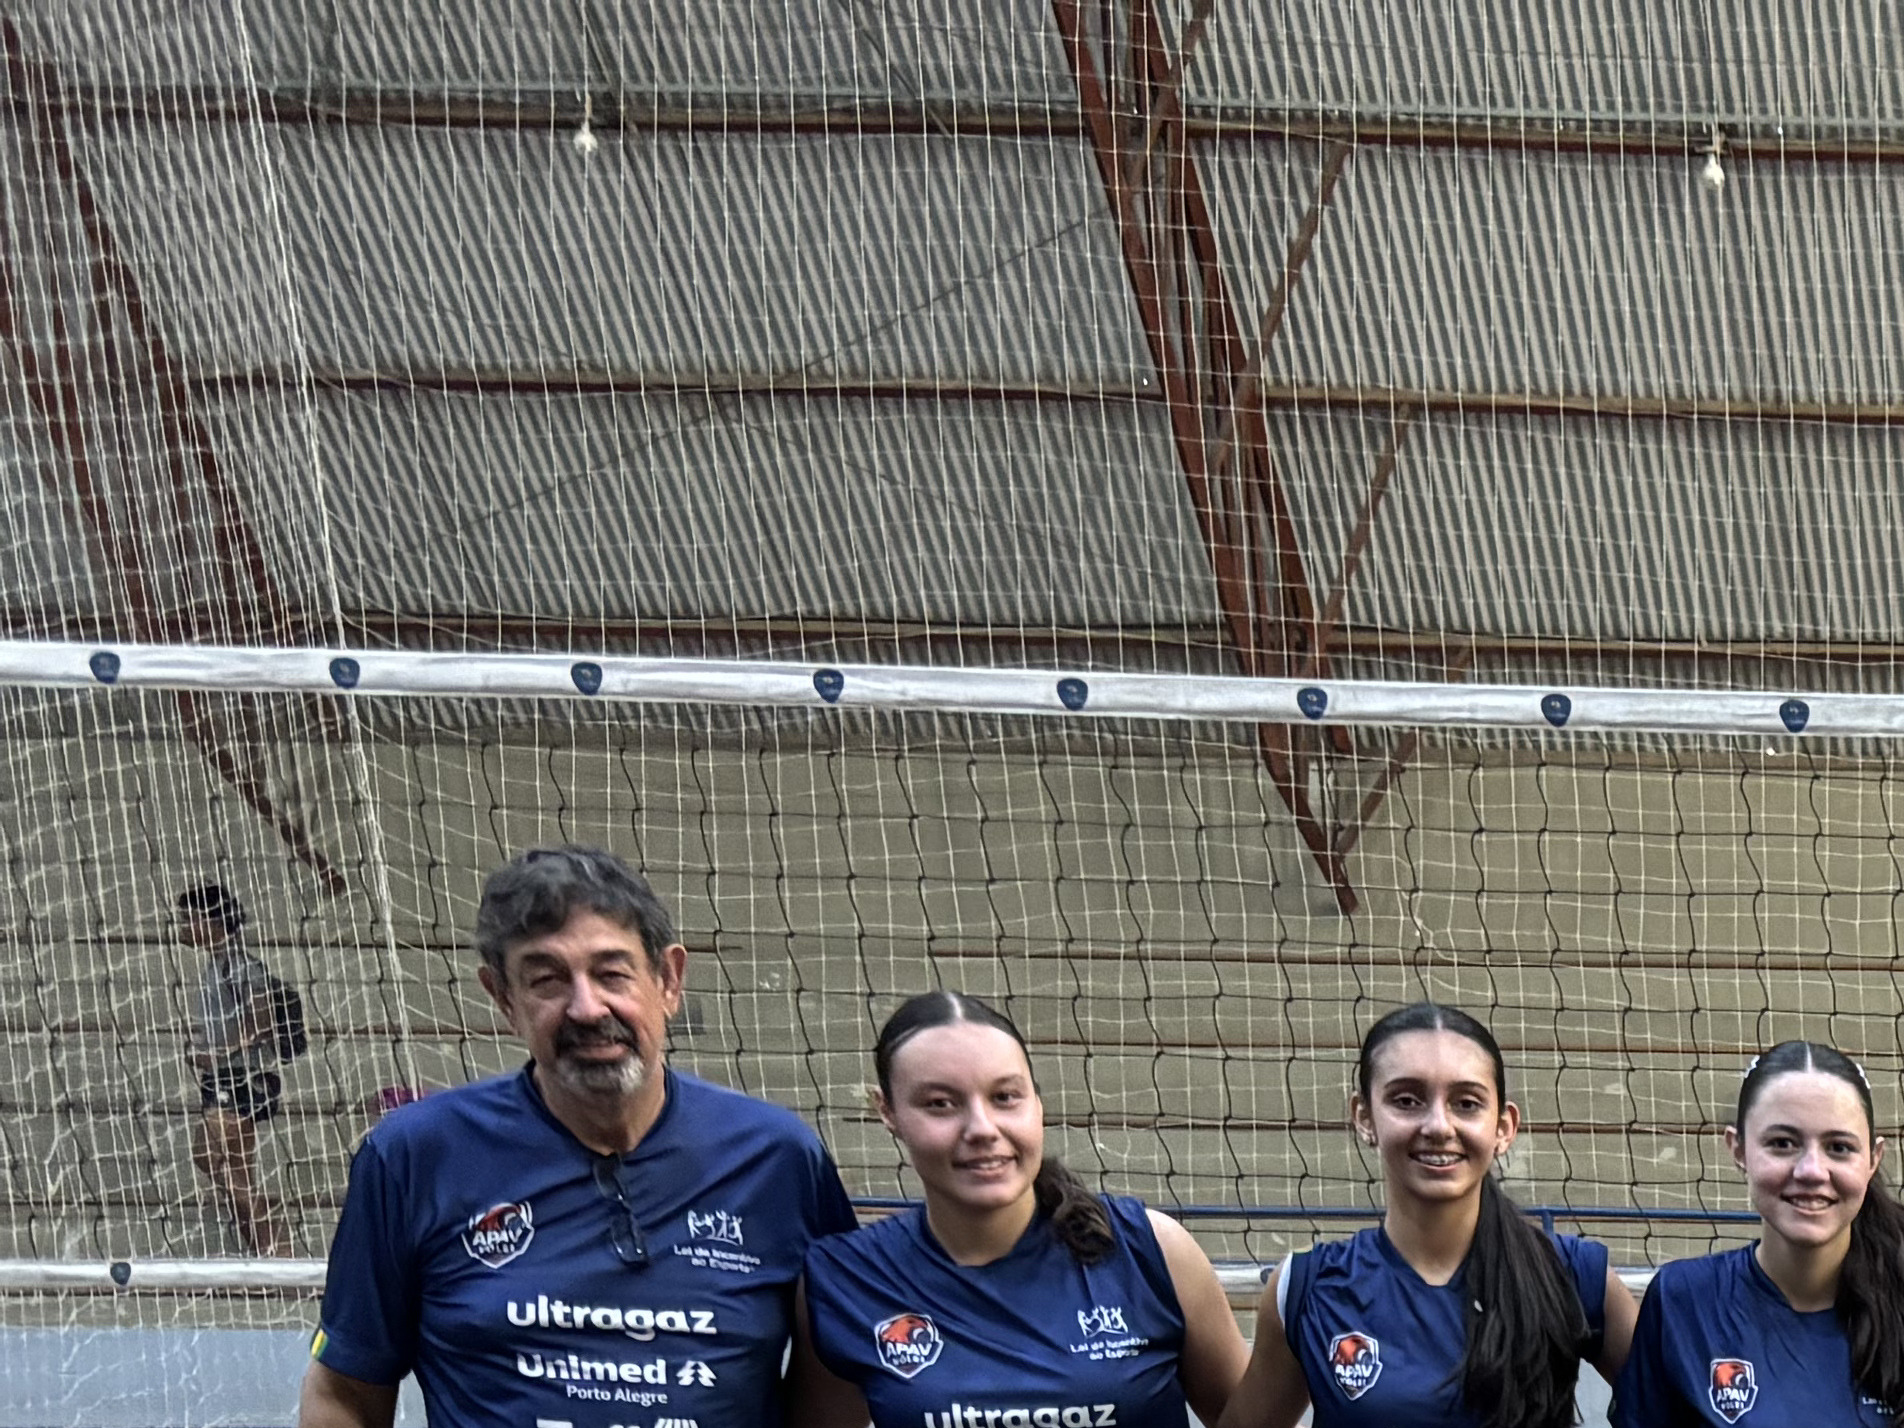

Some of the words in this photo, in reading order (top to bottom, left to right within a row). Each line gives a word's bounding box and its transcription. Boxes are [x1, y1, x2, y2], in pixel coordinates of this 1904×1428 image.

[507, 1295, 717, 1341] ultragaz
[517, 1352, 666, 1385] Unimed
[567, 1384, 610, 1401] Porto
[614, 1389, 668, 1406] Alegre
